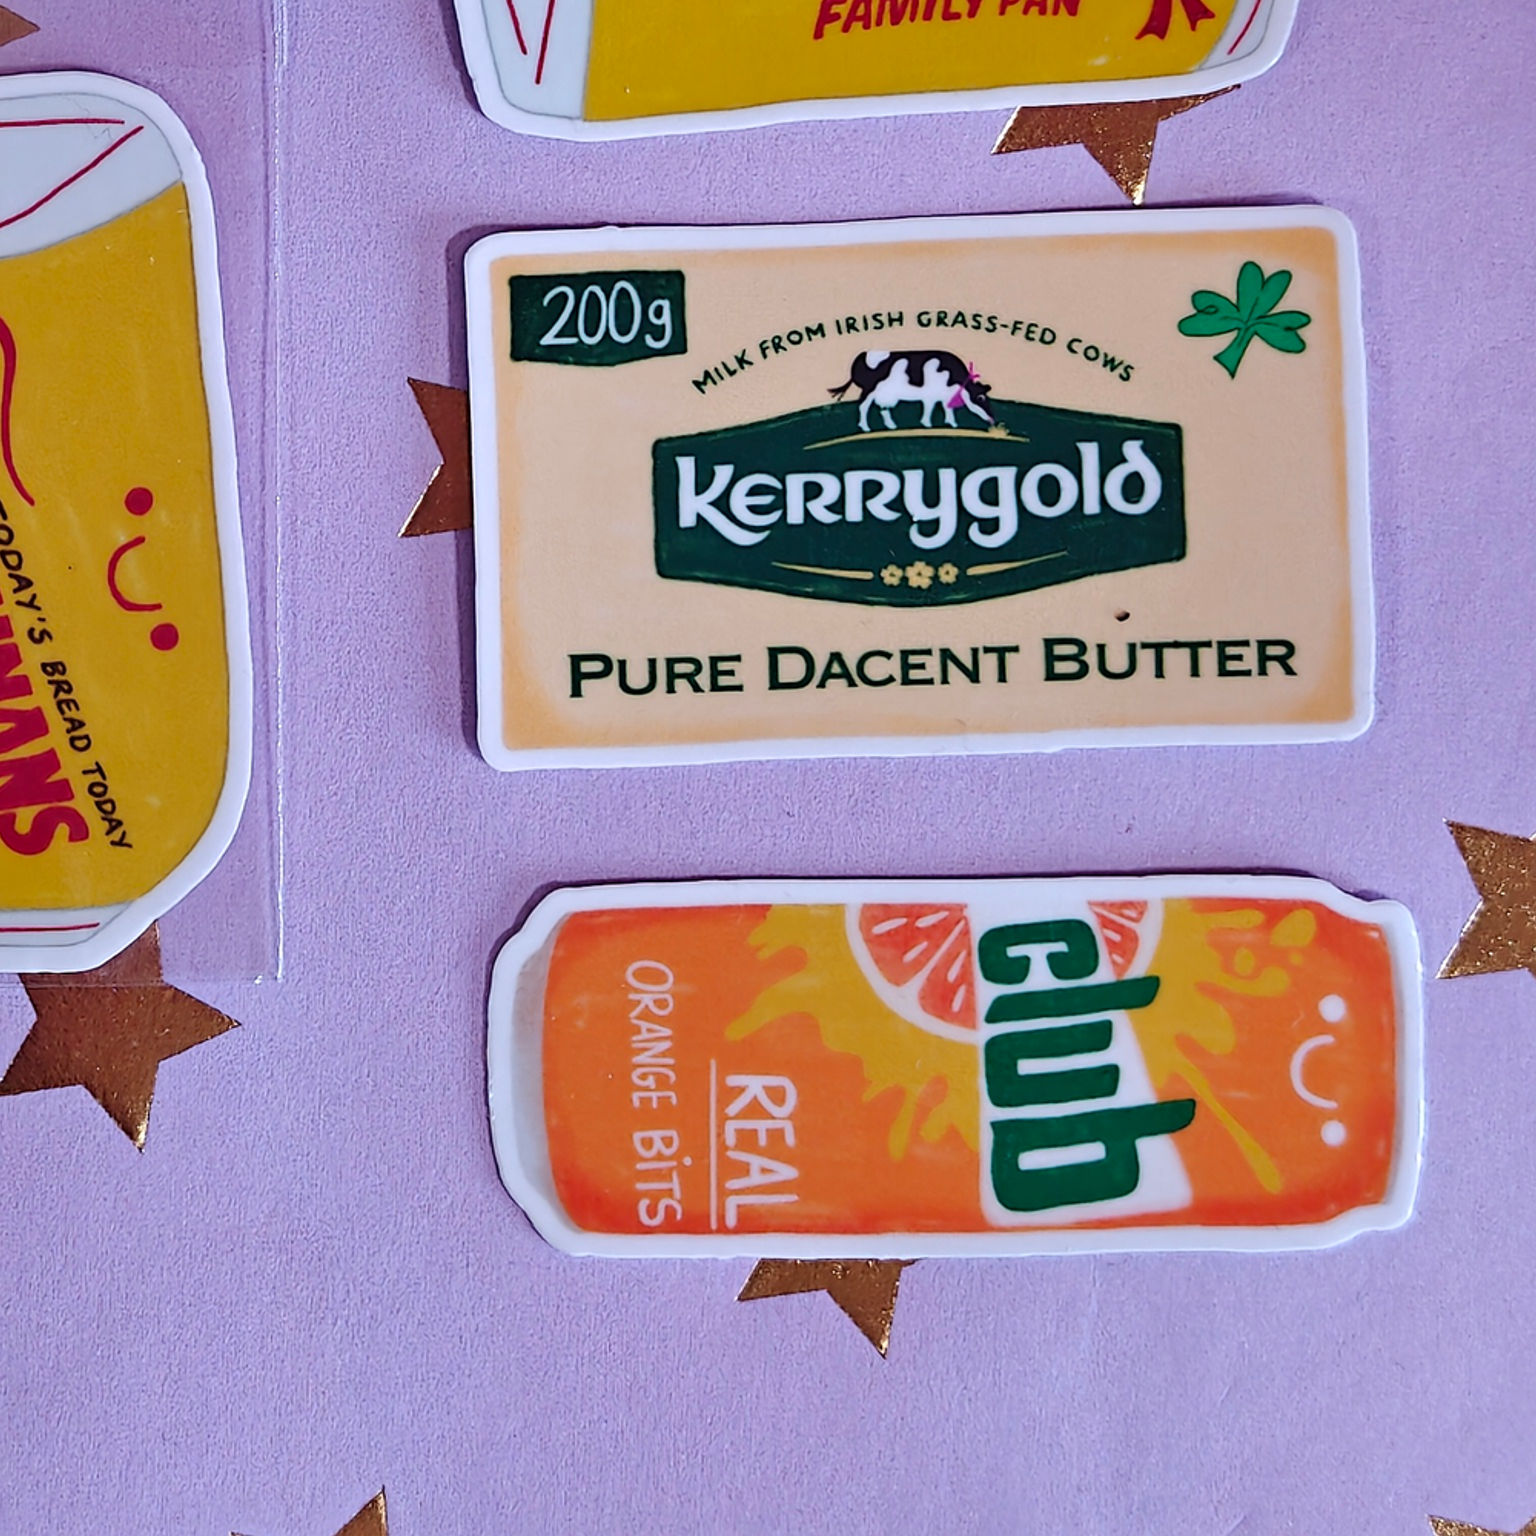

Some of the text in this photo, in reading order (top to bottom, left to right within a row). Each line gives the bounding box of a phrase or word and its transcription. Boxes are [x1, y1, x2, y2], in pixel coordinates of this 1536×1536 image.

[538, 280, 676, 350] 200g
[691, 309, 1136, 395] MILK FROM IRISH GRASS-FED COWS
[39, 660, 92, 754] BREAD
[80, 761, 133, 851] TODAY
[624, 959, 678, 1109] ORANGE
[977, 917, 1196, 1214] club
[724, 1073, 800, 1229] REAL
